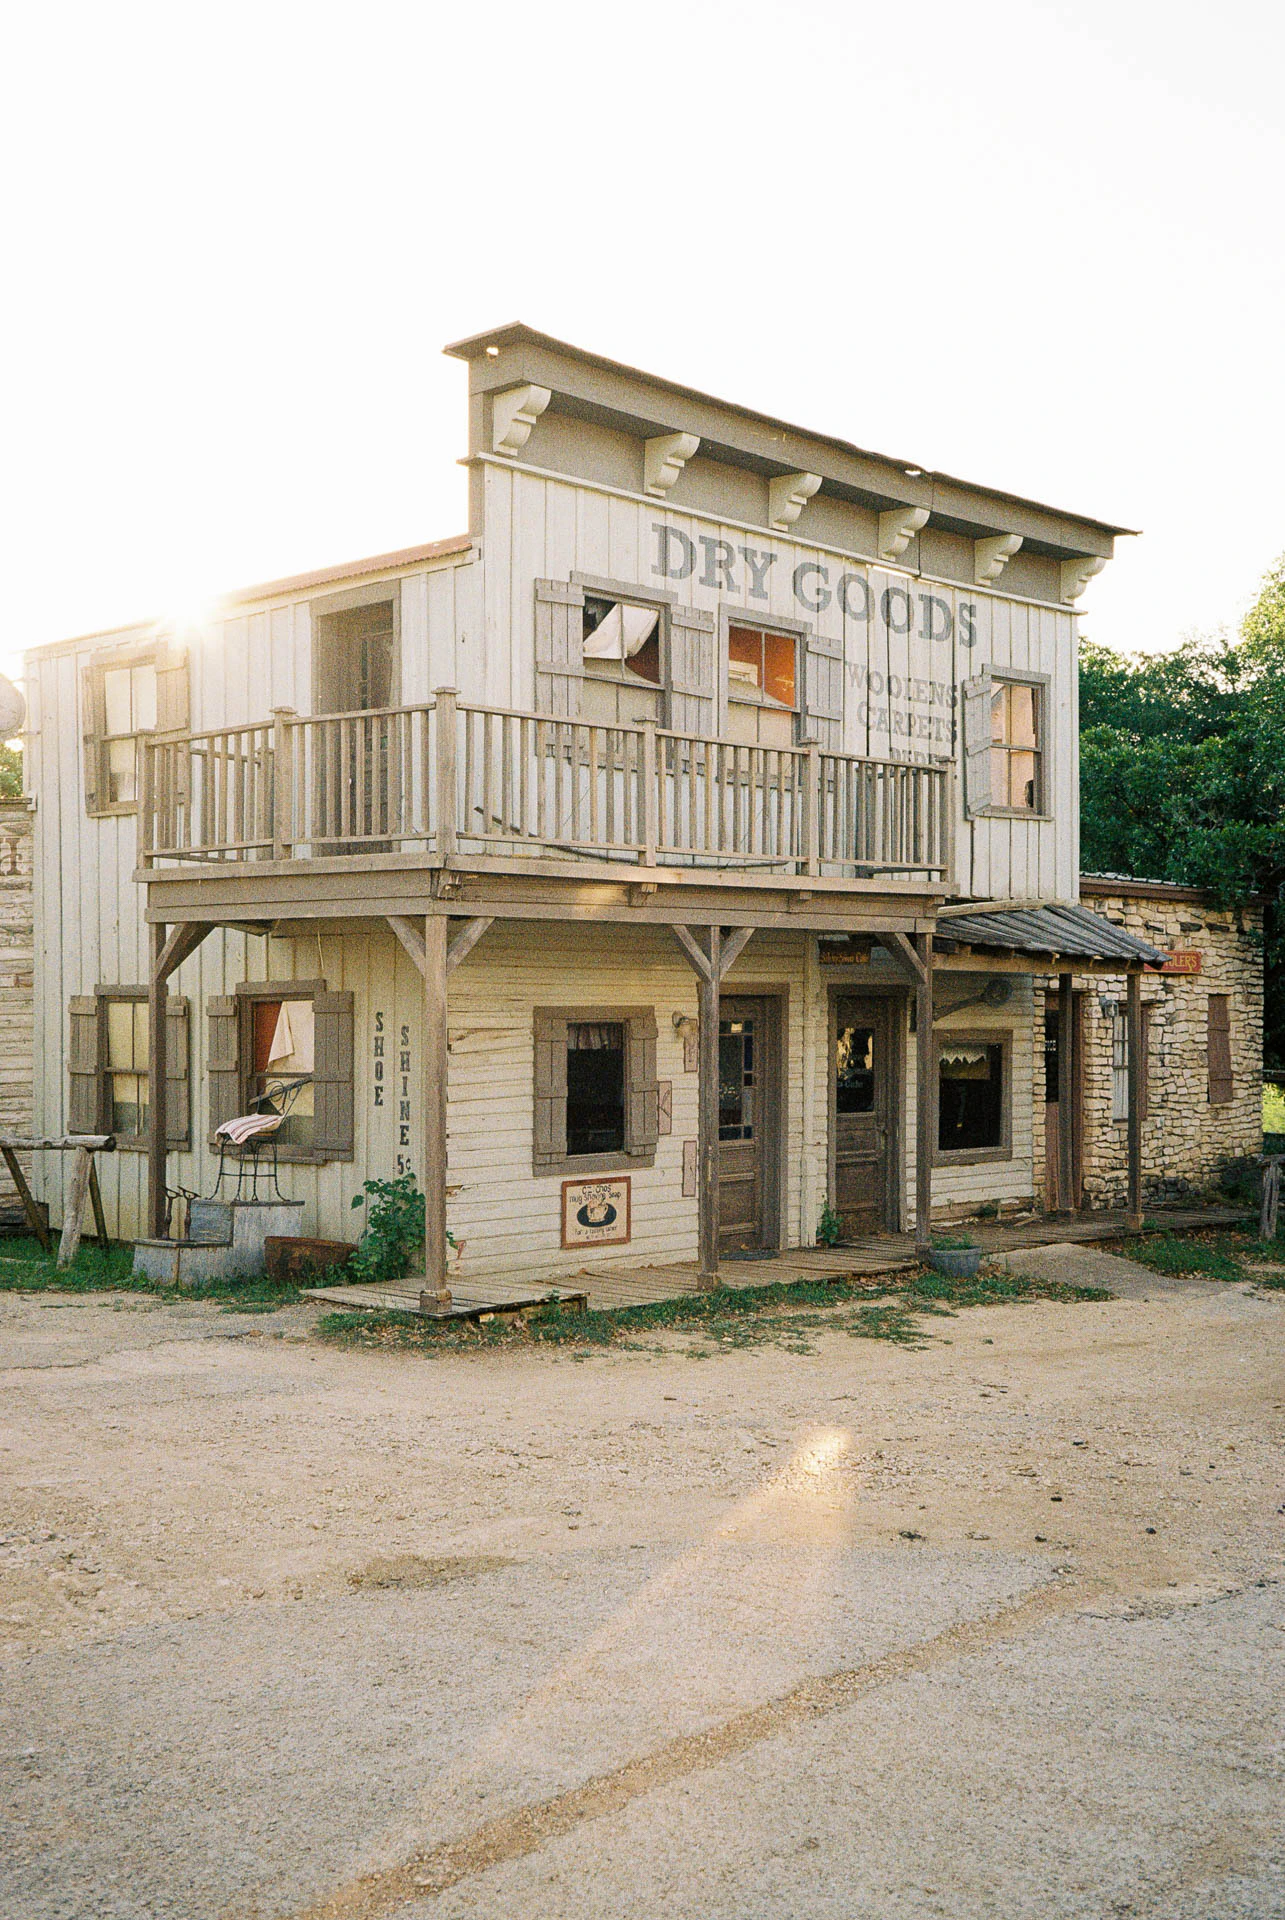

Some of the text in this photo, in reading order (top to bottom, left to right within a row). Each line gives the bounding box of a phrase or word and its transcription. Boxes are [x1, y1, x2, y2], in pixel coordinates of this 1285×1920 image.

[651, 522, 977, 647] DRY GOODS
[845, 660, 958, 709] WOOLENS
[857, 700, 958, 745] CARPETS
[374, 1011, 384, 1106] SHOE
[400, 1025, 411, 1146] SHINE
